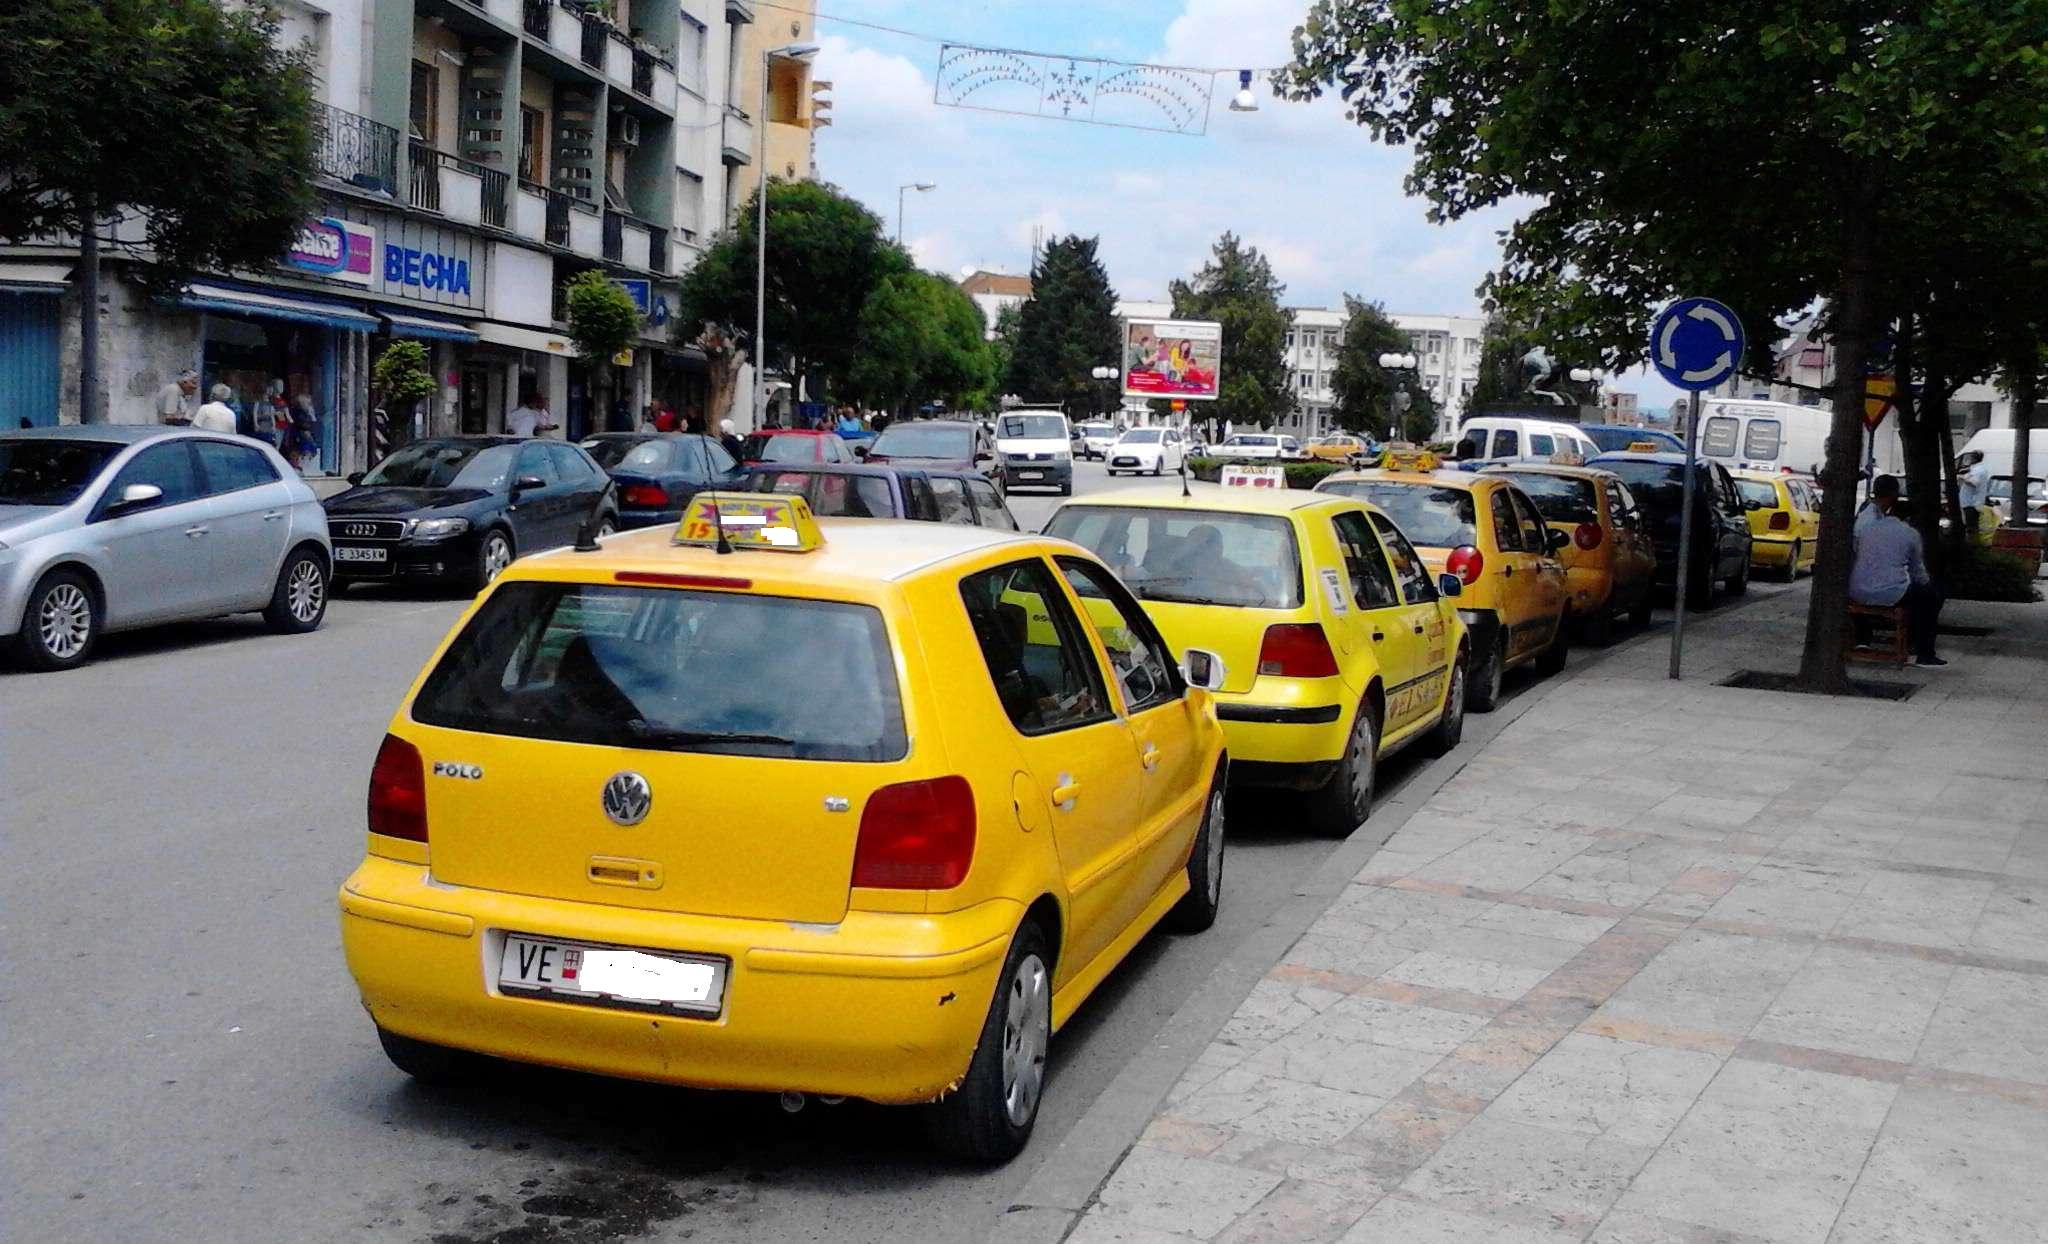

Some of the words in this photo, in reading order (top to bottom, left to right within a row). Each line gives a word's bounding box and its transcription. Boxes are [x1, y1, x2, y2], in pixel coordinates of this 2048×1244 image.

[385, 243, 471, 295] ВЕСНА
[686, 522, 711, 538] 15
[433, 762, 483, 779] POLO
[519, 942, 557, 982] VE
